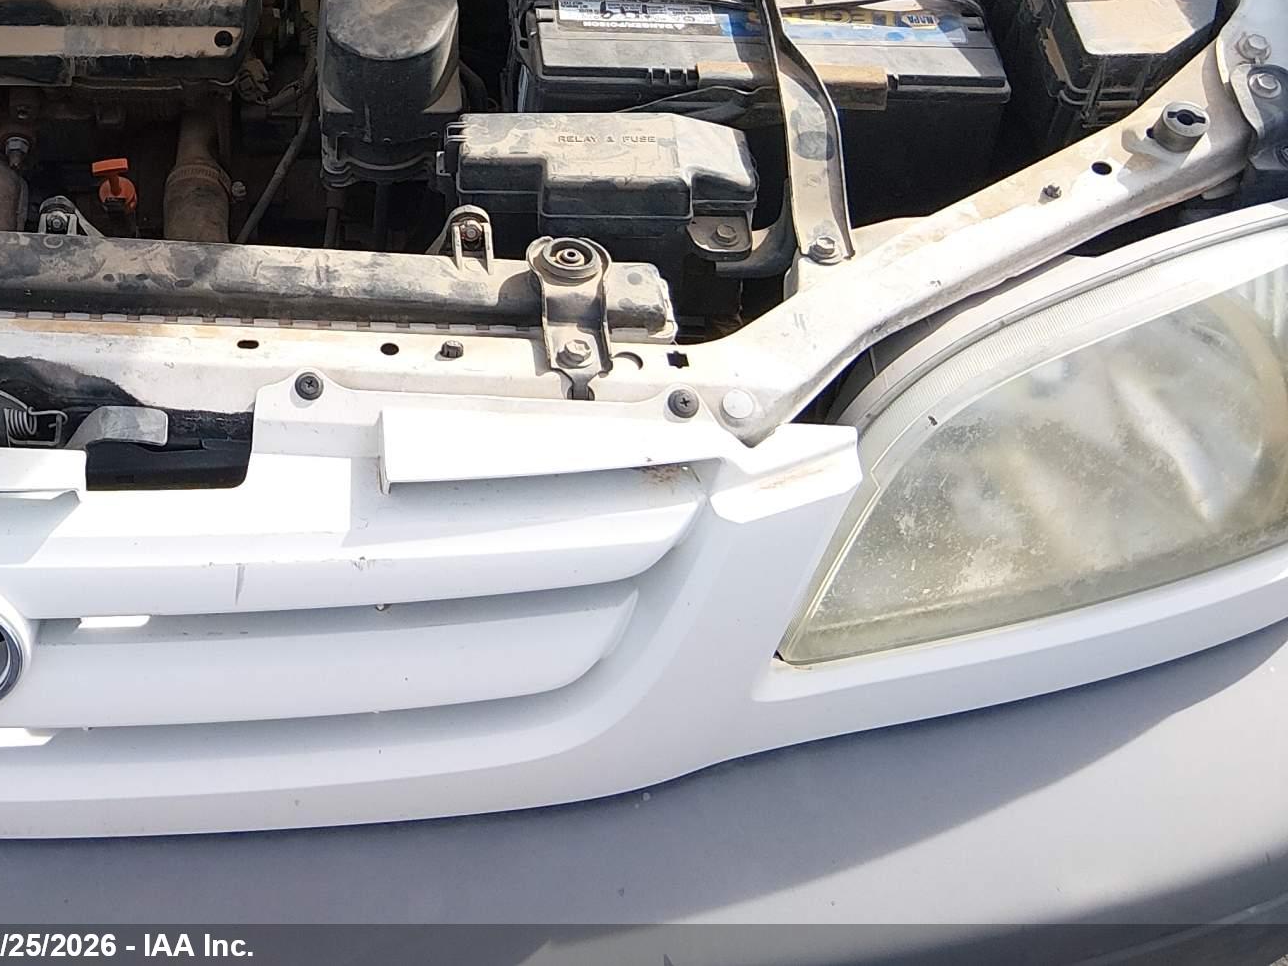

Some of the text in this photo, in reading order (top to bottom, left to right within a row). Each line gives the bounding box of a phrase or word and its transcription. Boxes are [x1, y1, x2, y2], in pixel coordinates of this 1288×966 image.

[905, 14, 934, 26] NAPA
[558, 135, 656, 143] RELAY & FUSE
